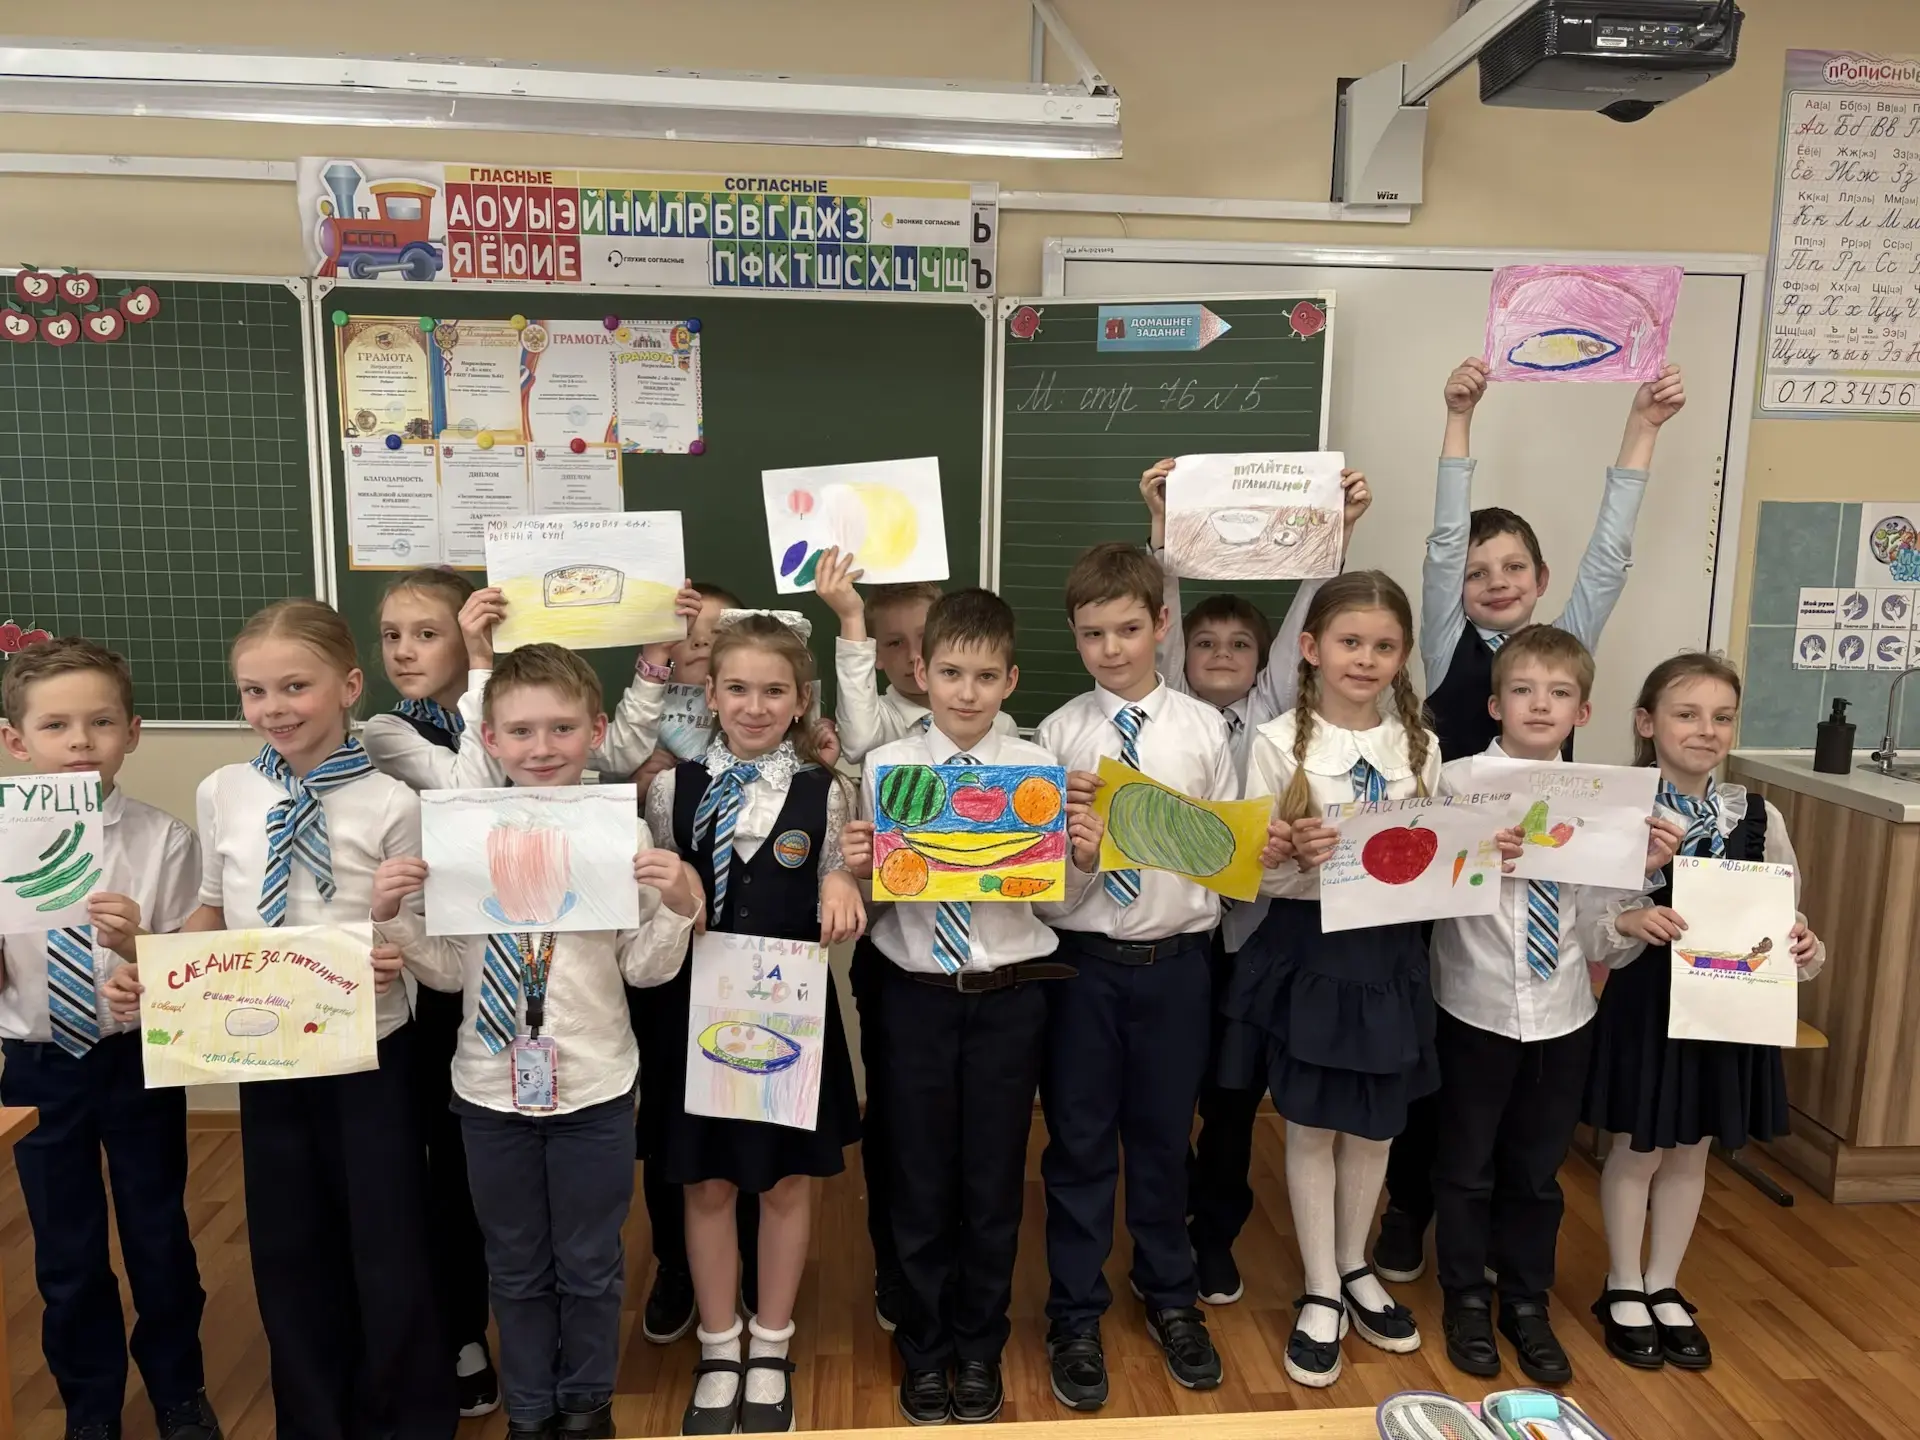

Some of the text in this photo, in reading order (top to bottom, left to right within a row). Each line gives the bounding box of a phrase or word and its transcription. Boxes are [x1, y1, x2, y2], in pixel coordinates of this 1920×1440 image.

[470, 168, 553, 185] ГЛАСНЫЕ
[725, 177, 828, 193] СОГЛАСНЫЕ
[450, 195, 576, 230] А О У Ы Э
[582, 190, 864, 240] Й Н М Л Р Б В Г Д Ж З
[973, 212, 992, 243] Ь
[453, 235, 577, 276] Я Ё Ю И Е
[716, 251, 969, 292] П Ф К Т Ш С Х Ц Ч Щ
[971, 259, 992, 289] Ъ
[31, 281, 85, 296] 2 Б
[1130, 317, 1193, 328] ДОМАШНЕЕ
[553, 333, 609, 345] ГРАМОТА
[1136, 327, 1186, 337] ЗАДАНИЕ
[358, 353, 414, 363] ГРАМОТА
[618, 351, 674, 365] ГРАМОТА
[1160, 378, 1197, 410] 76
[1778, 381, 1915, 405] 0 1 2 3 4 5 6
[1234, 459, 1304, 476] ПИТАЙТЕСЬ
[487, 521, 508, 532] МОЯ
[168, 952, 256, 990] СЛЕДИТЕ
